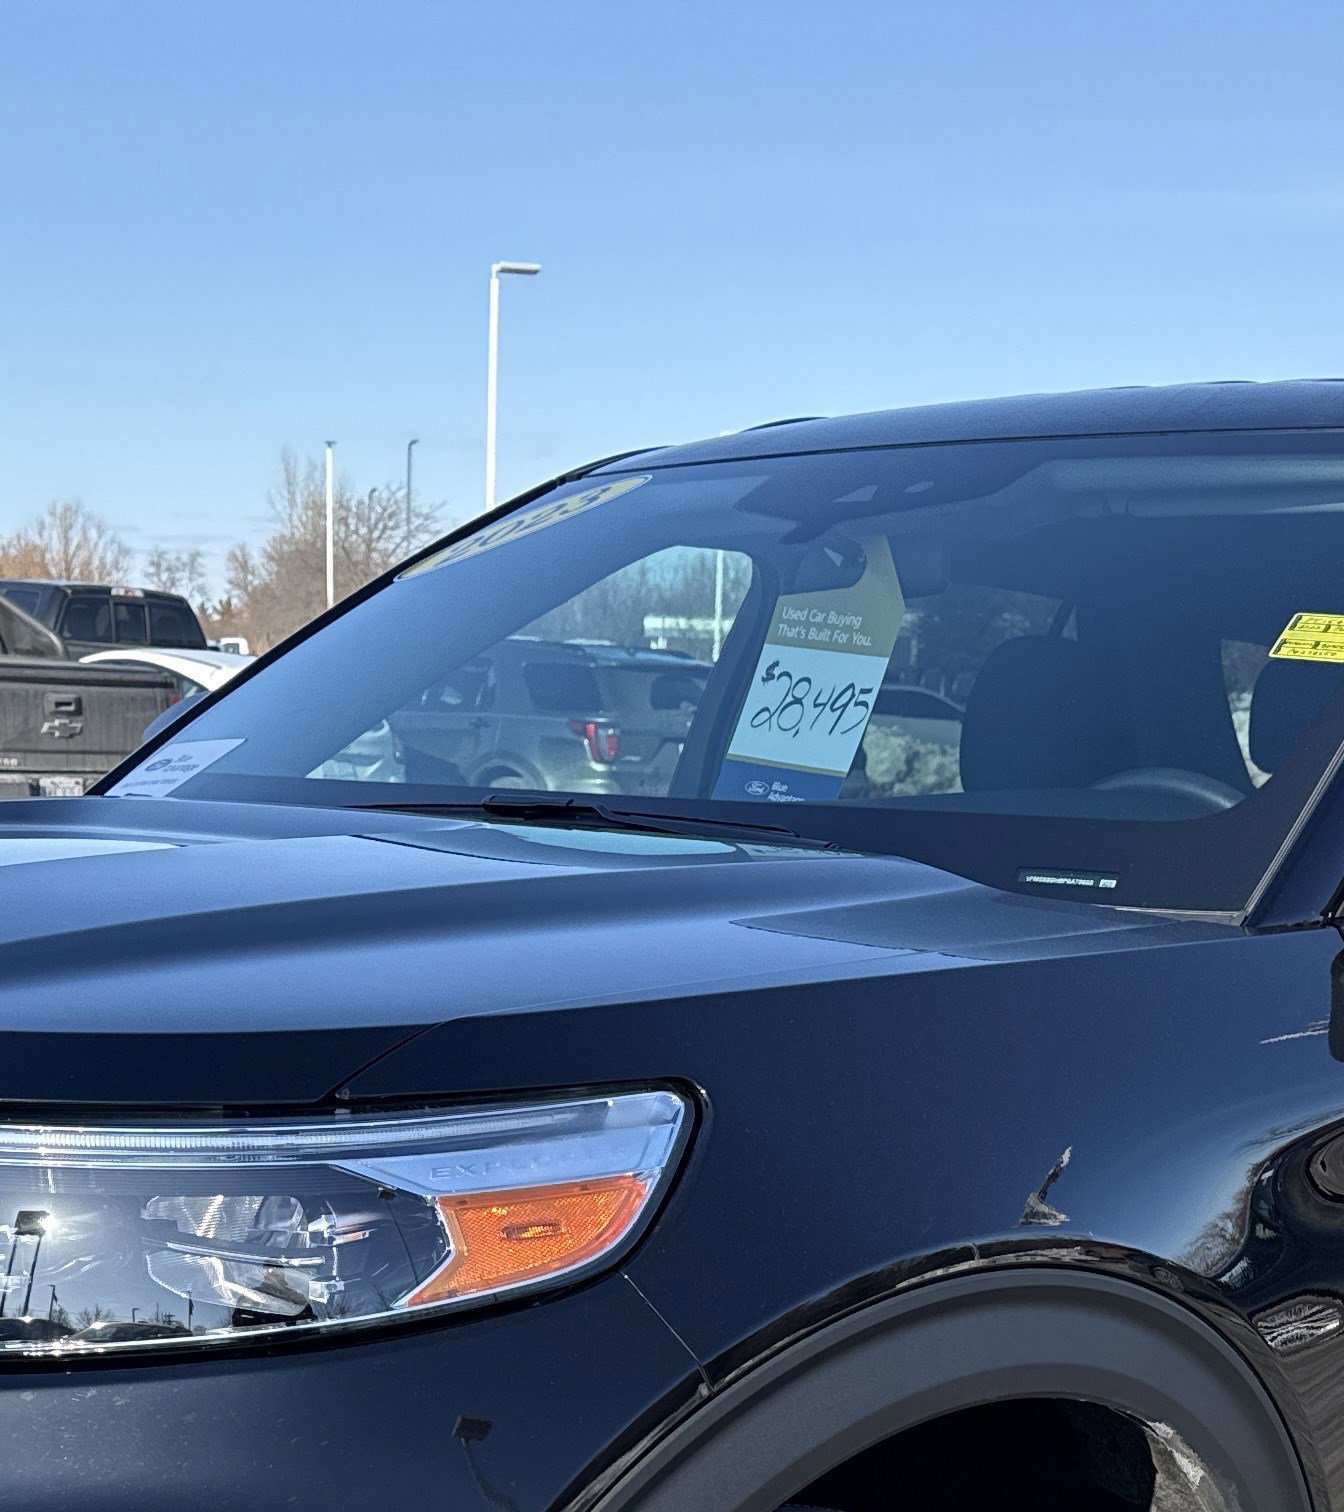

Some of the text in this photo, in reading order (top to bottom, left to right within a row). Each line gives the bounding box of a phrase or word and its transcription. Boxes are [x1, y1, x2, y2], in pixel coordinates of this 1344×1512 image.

[782, 606, 862, 629] Used Car Buying
[777, 623, 872, 647] That's Built For You.
[750, 660, 874, 738] $28,495
[771, 781, 789, 792] Blue
